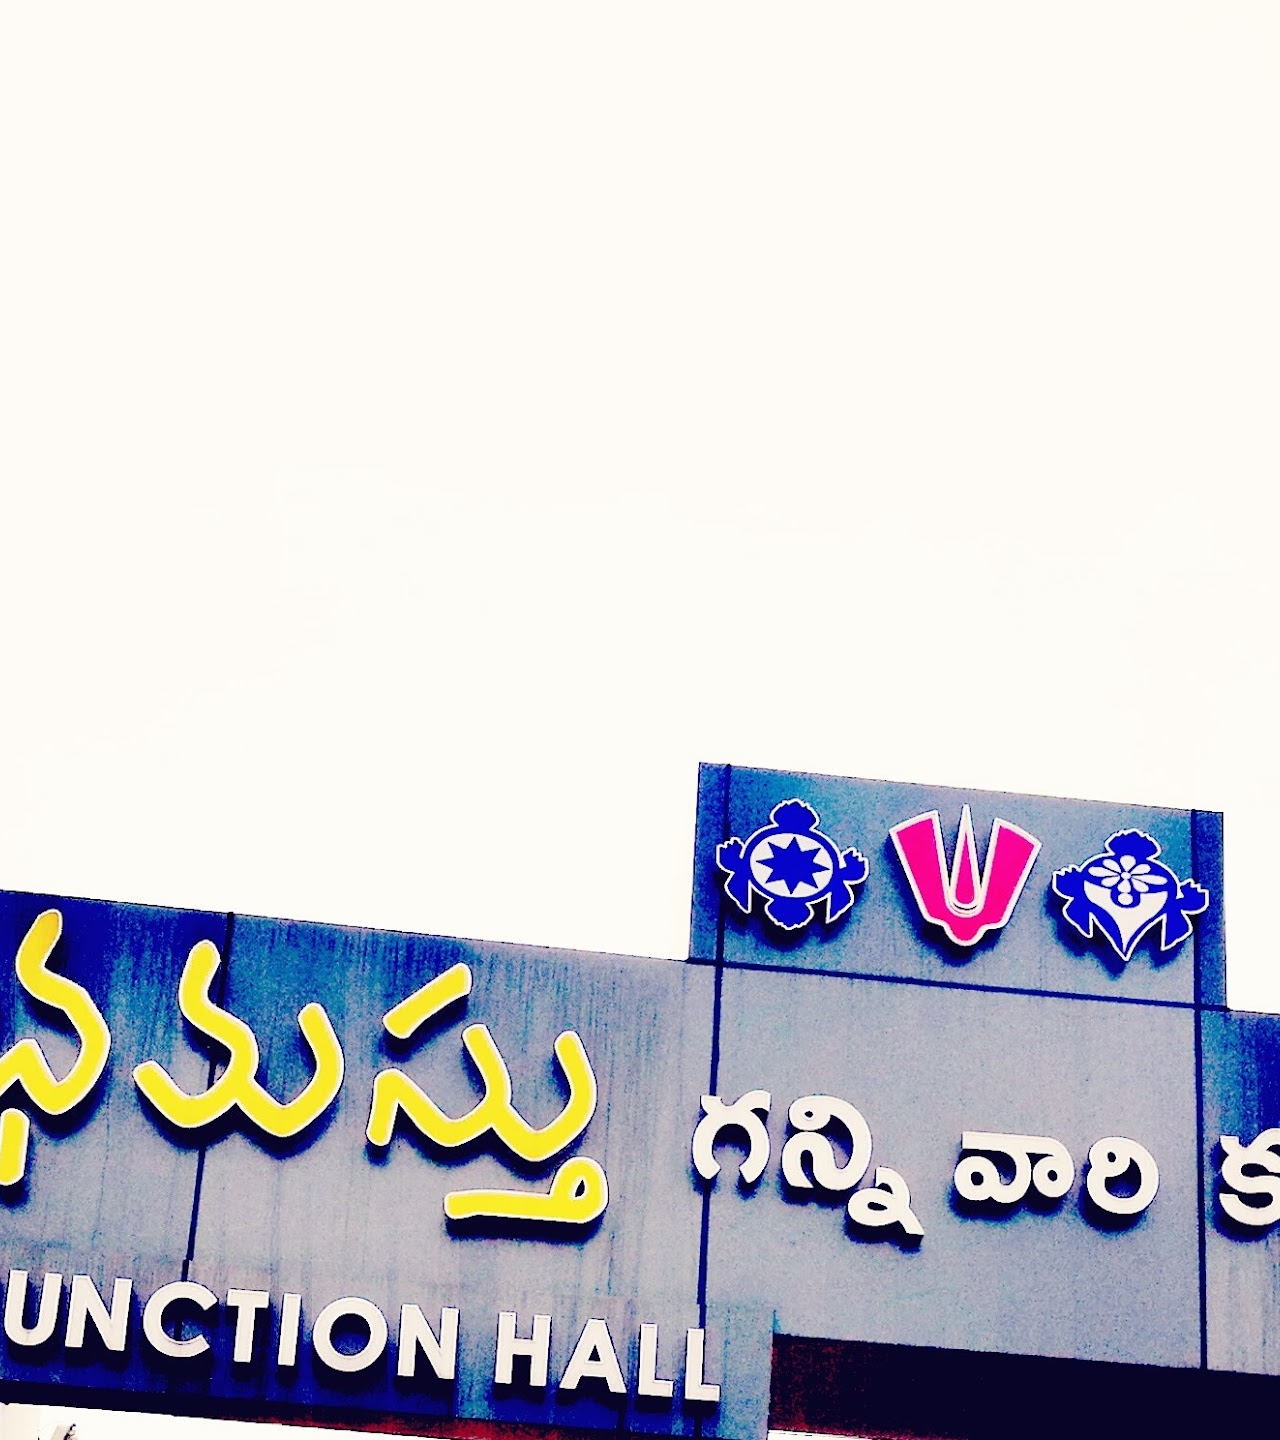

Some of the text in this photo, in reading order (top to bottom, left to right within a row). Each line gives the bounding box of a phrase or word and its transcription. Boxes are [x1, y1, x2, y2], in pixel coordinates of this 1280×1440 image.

[692, 1090, 924, 1235] గన్ని
[954, 1131, 1159, 1214] వారి
[493, 1310, 720, 1403] HALL
